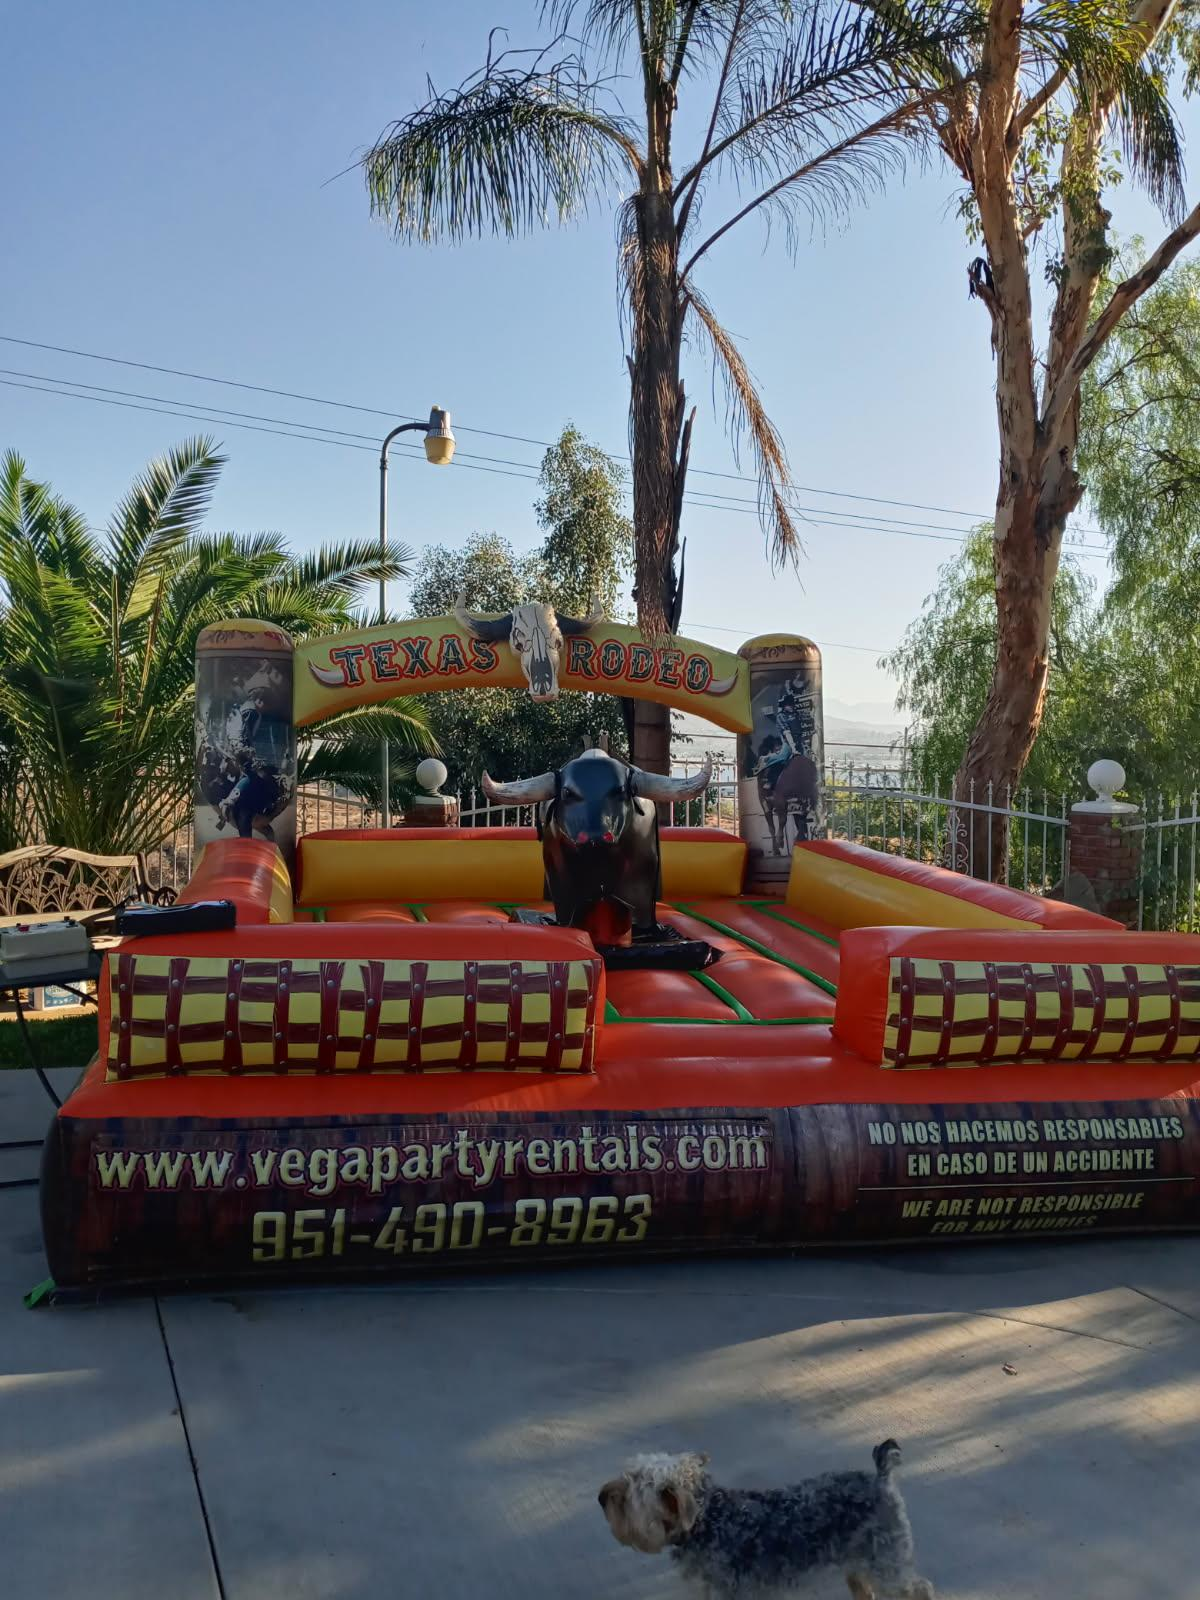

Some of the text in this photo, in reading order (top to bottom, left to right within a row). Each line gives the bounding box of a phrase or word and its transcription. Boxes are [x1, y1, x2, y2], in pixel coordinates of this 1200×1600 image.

[332, 634, 713, 693] TEXAS RODEO
[868, 1116, 1184, 1145] NO NOS HACEMOS RESPONSABLES
[96, 1125, 767, 1194] www.vegapartyrentals.com
[907, 1148, 1154, 1177] EN CASO DE UN ACCIDENTE
[901, 1192, 1144, 1218] WE ARE NOT RESPONSIBLE
[252, 1193, 652, 1262] 951-490-8963
